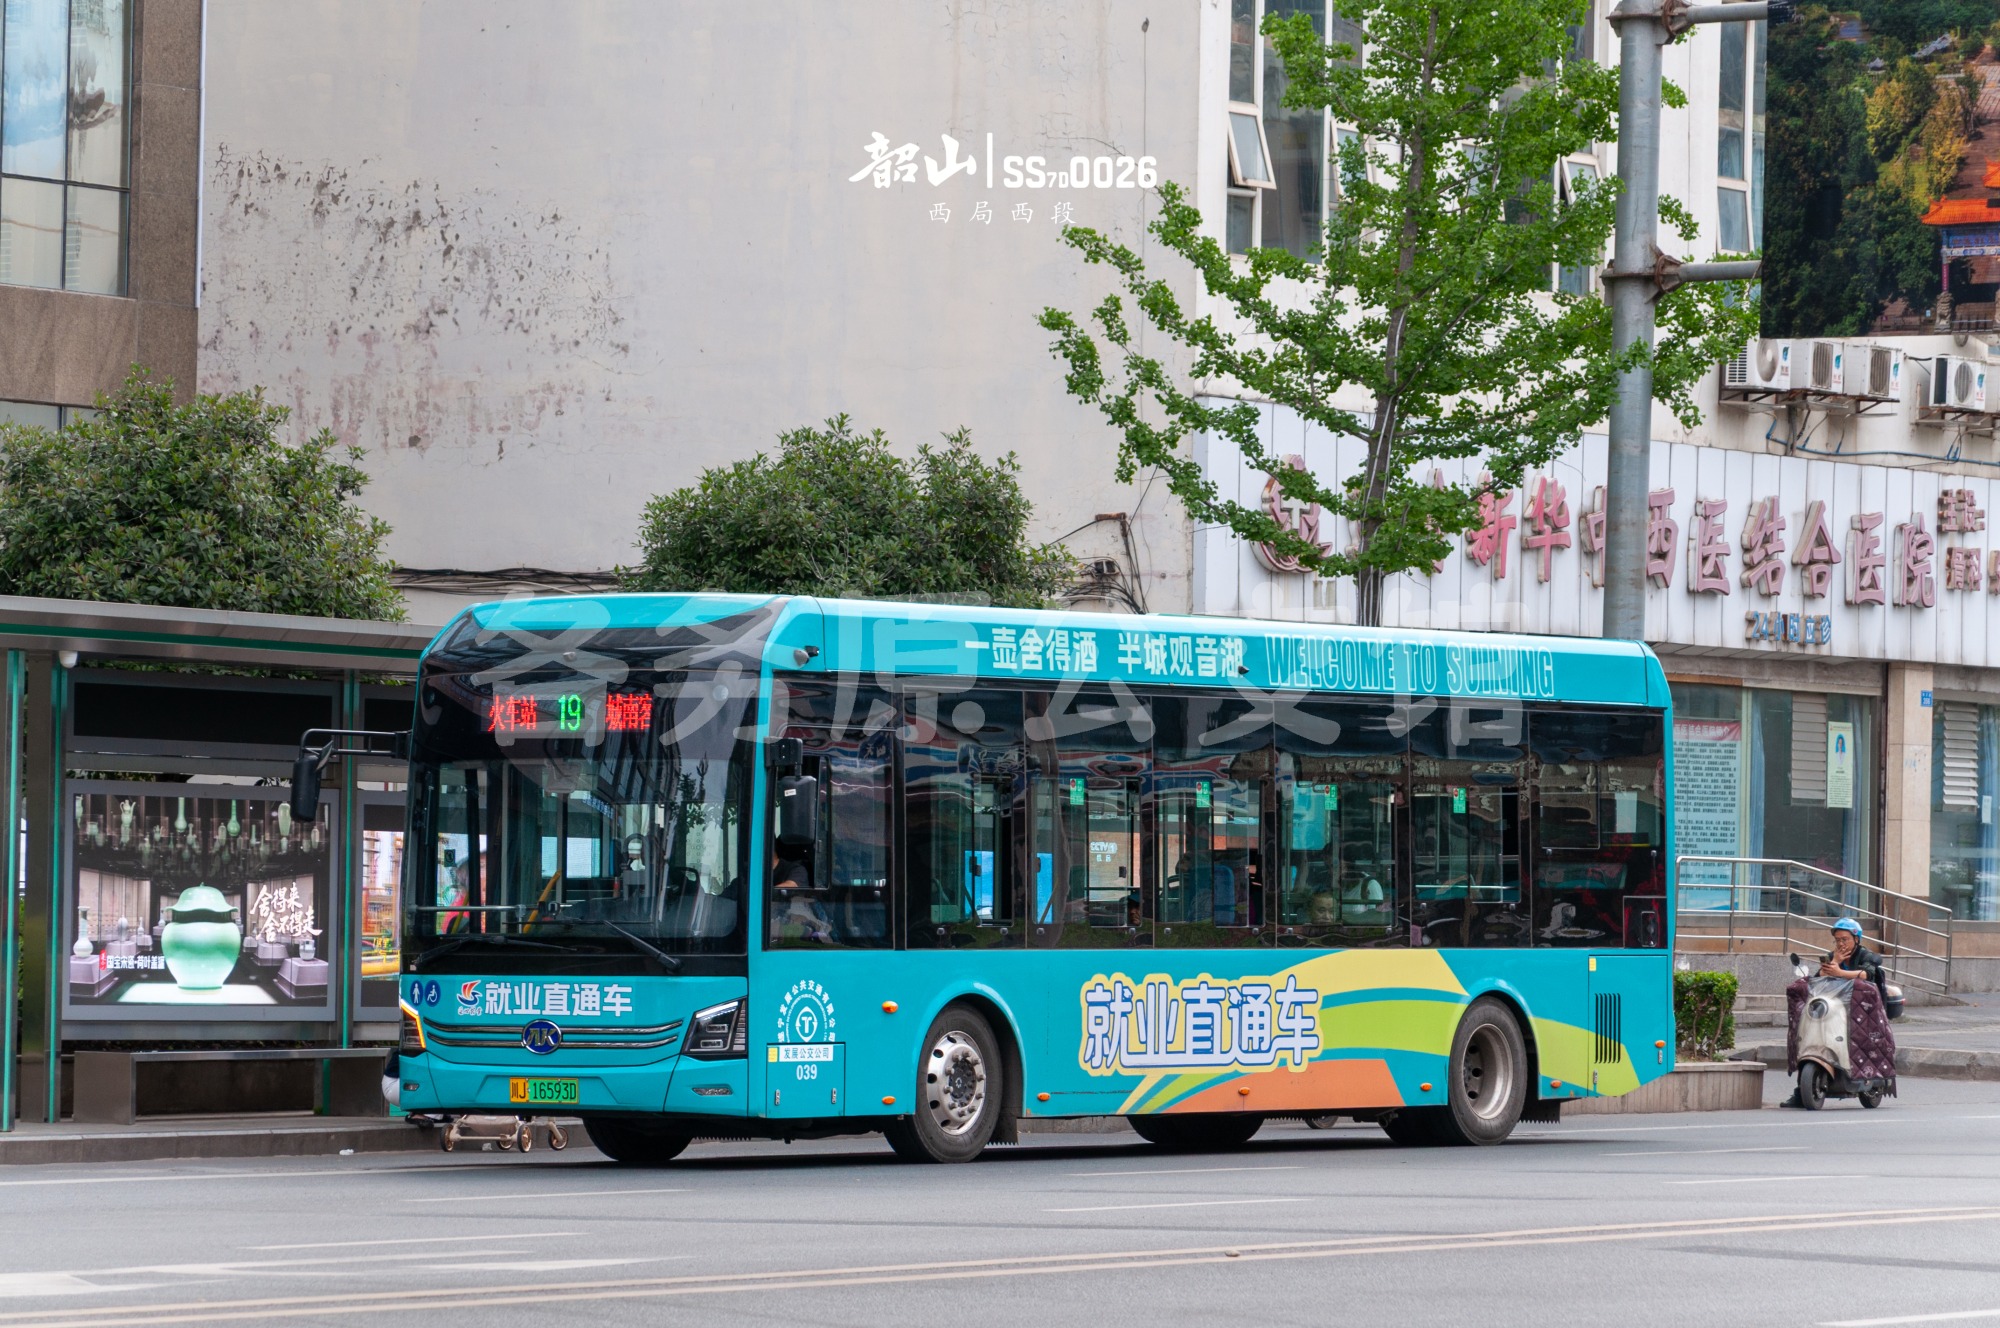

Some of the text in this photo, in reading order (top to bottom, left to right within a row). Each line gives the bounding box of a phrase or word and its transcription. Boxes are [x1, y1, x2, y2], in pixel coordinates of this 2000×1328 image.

[965, 626, 1245, 678] 一壶舍得酒 半城观音湖
[1264, 633, 1555, 698] WELCOME TO SUINING
[488, 694, 538, 732] 火车站
[558, 694, 582, 731] 19
[249, 882, 303, 917] 舍得来
[255, 905, 323, 943] 舍不得走
[485, 982, 633, 1017] 就业直通车
[1084, 974, 1319, 1069] 就业直通车
[784, 1047, 830, 1060] 发展公交公司
[796, 1064, 818, 1080] 039
